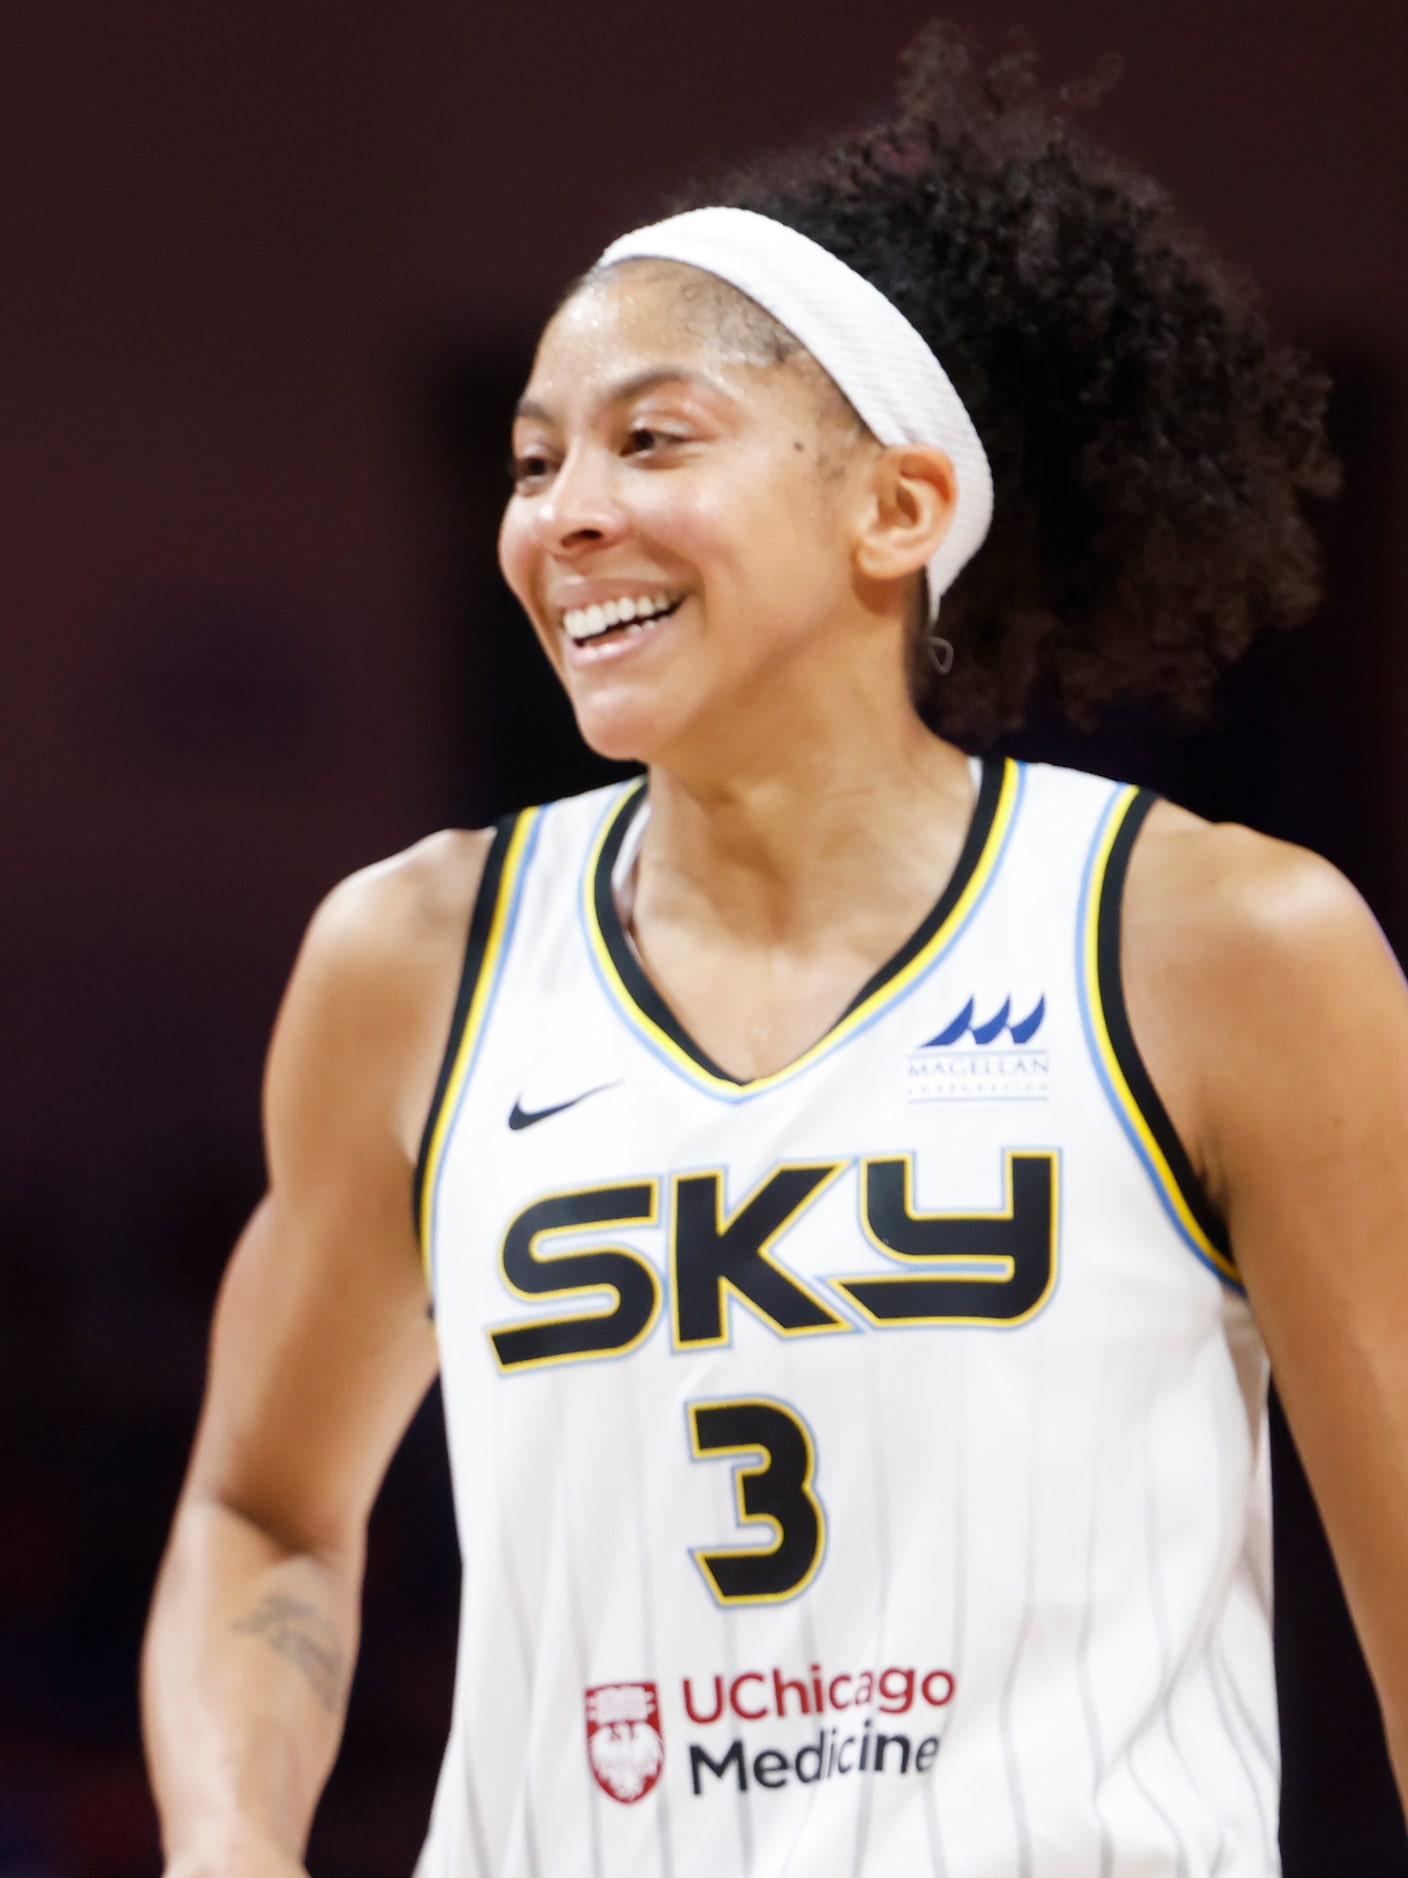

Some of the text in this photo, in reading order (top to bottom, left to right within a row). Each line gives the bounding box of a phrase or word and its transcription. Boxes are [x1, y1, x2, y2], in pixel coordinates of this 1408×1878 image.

[485, 1146, 1062, 1377] SKY
[684, 1392, 828, 1609] 3
[682, 1662, 956, 1724] UChicago
[689, 1719, 940, 1796] Medicine
